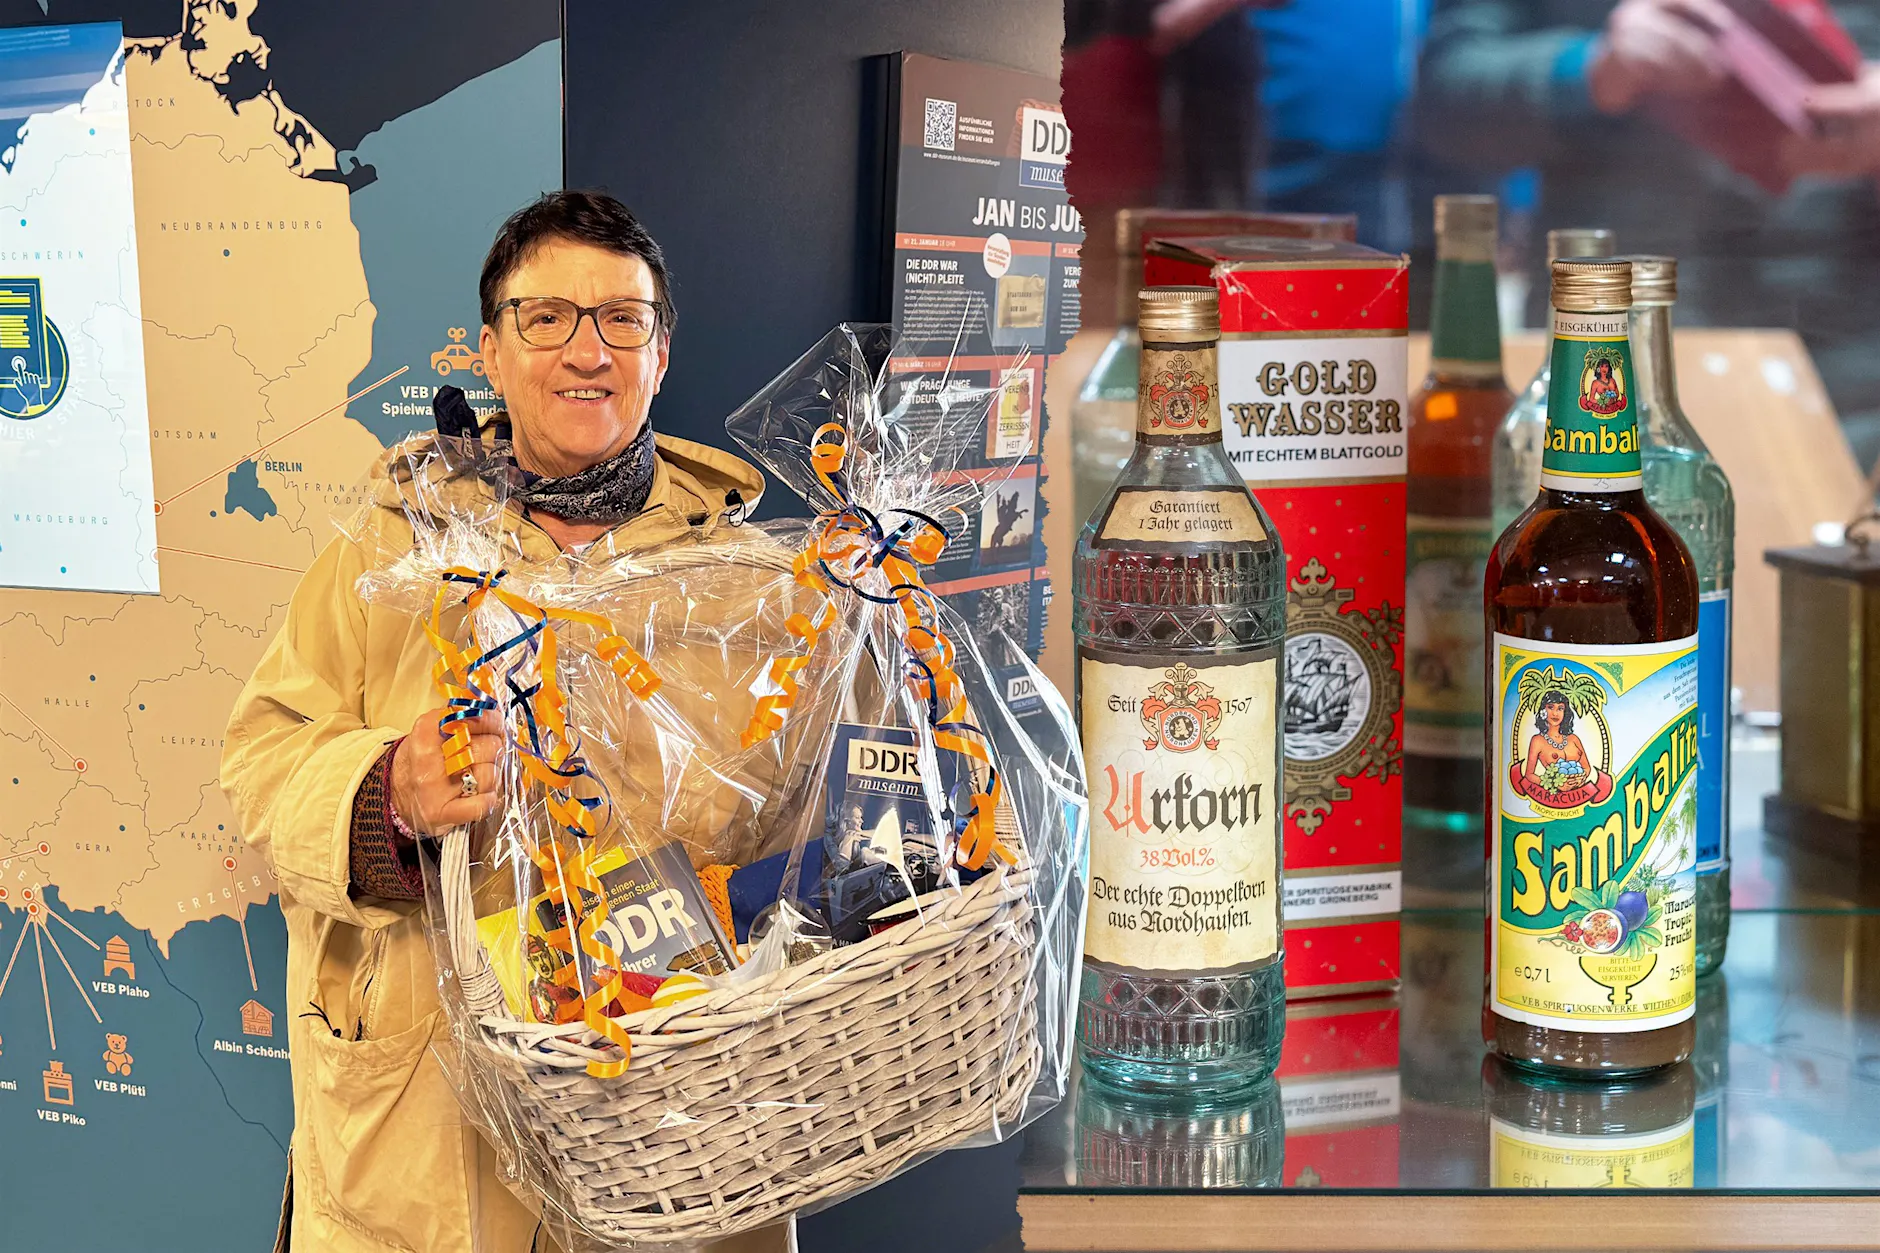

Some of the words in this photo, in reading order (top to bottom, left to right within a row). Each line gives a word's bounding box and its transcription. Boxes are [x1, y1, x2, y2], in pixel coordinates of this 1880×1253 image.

[1032, 119, 1073, 155] DD
[972, 197, 1015, 227] JAN
[1020, 206, 1047, 230] BIS
[161, 220, 322, 231] NEUBRANDENBURG
[1, 250, 84, 260] SCHWERIN
[906, 259, 921, 270] DIE
[921, 260, 939, 271] DDR
[940, 260, 958, 271] WAR
[905, 272, 936, 285] (NICHT)
[937, 274, 964, 285] PLEITE
[1063, 279, 1079, 288] ZUK
[1560, 321, 1620, 332] EISGEKÜHLT
[1256, 359, 1377, 397] GOLD
[401, 386, 429, 399] VEB
[382, 402, 435, 418] Spielwa
[1228, 399, 1402, 437] WASSER
[1228, 449, 1255, 463] MIT
[1256, 448, 1317, 462] ECHTEM
[1321, 445, 1403, 461] BLATTGOLD
[265, 461, 303, 473] BERLIN
[1149, 500, 1220, 514] Garantiert
[14, 513, 108, 525] MAGDEBURG
[1145, 517, 1180, 533] Jahr
[1184, 517, 1233, 533] gelagert
[44, 697, 90, 708] HALLE
[1107, 694, 1137, 714] Seit
[1224, 696, 1253, 715] 1507
[860, 747, 921, 777] DDR
[858, 779, 920, 796] museum
[1527, 784, 1591, 805] MARACUJA
[1103, 763, 1263, 838] Urkorn
[1534, 804, 1580, 818] TROPIC-FRUCHT
[181, 831, 247, 844] KARL-M
[75, 842, 111, 853] GERA
[197, 842, 245, 854] STADT
[610, 879, 636, 895] einen
[634, 878, 660, 895] Staat
[1093, 876, 1120, 902] Der
[1124, 883, 1163, 911] echte
[1168, 879, 1266, 912] Doppelkorn
[1296, 882, 1393, 897] SPIRITUOSENFABRIK
[1108, 912, 1137, 931] aus
[1664, 912, 1693, 931] Tropic-
[1664, 928, 1692, 947] Frucht
[1598, 965, 1643, 974] EISGEKÜHLT
[1601, 974, 1639, 982] SERVIEREN
[92, 980, 116, 994] VEB
[118, 983, 150, 998] Plaho
[1522, 995, 1540, 1007] VEB
[1643, 997, 1677, 1011] WILTHEN
[213, 1040, 243, 1054] Albin
[0, 1079, 17, 1092] nni
[94, 1079, 118, 1093] VEB
[120, 1080, 146, 1097] Plüti
[37, 1109, 60, 1122] VEB
[62, 1111, 86, 1126] Piko
